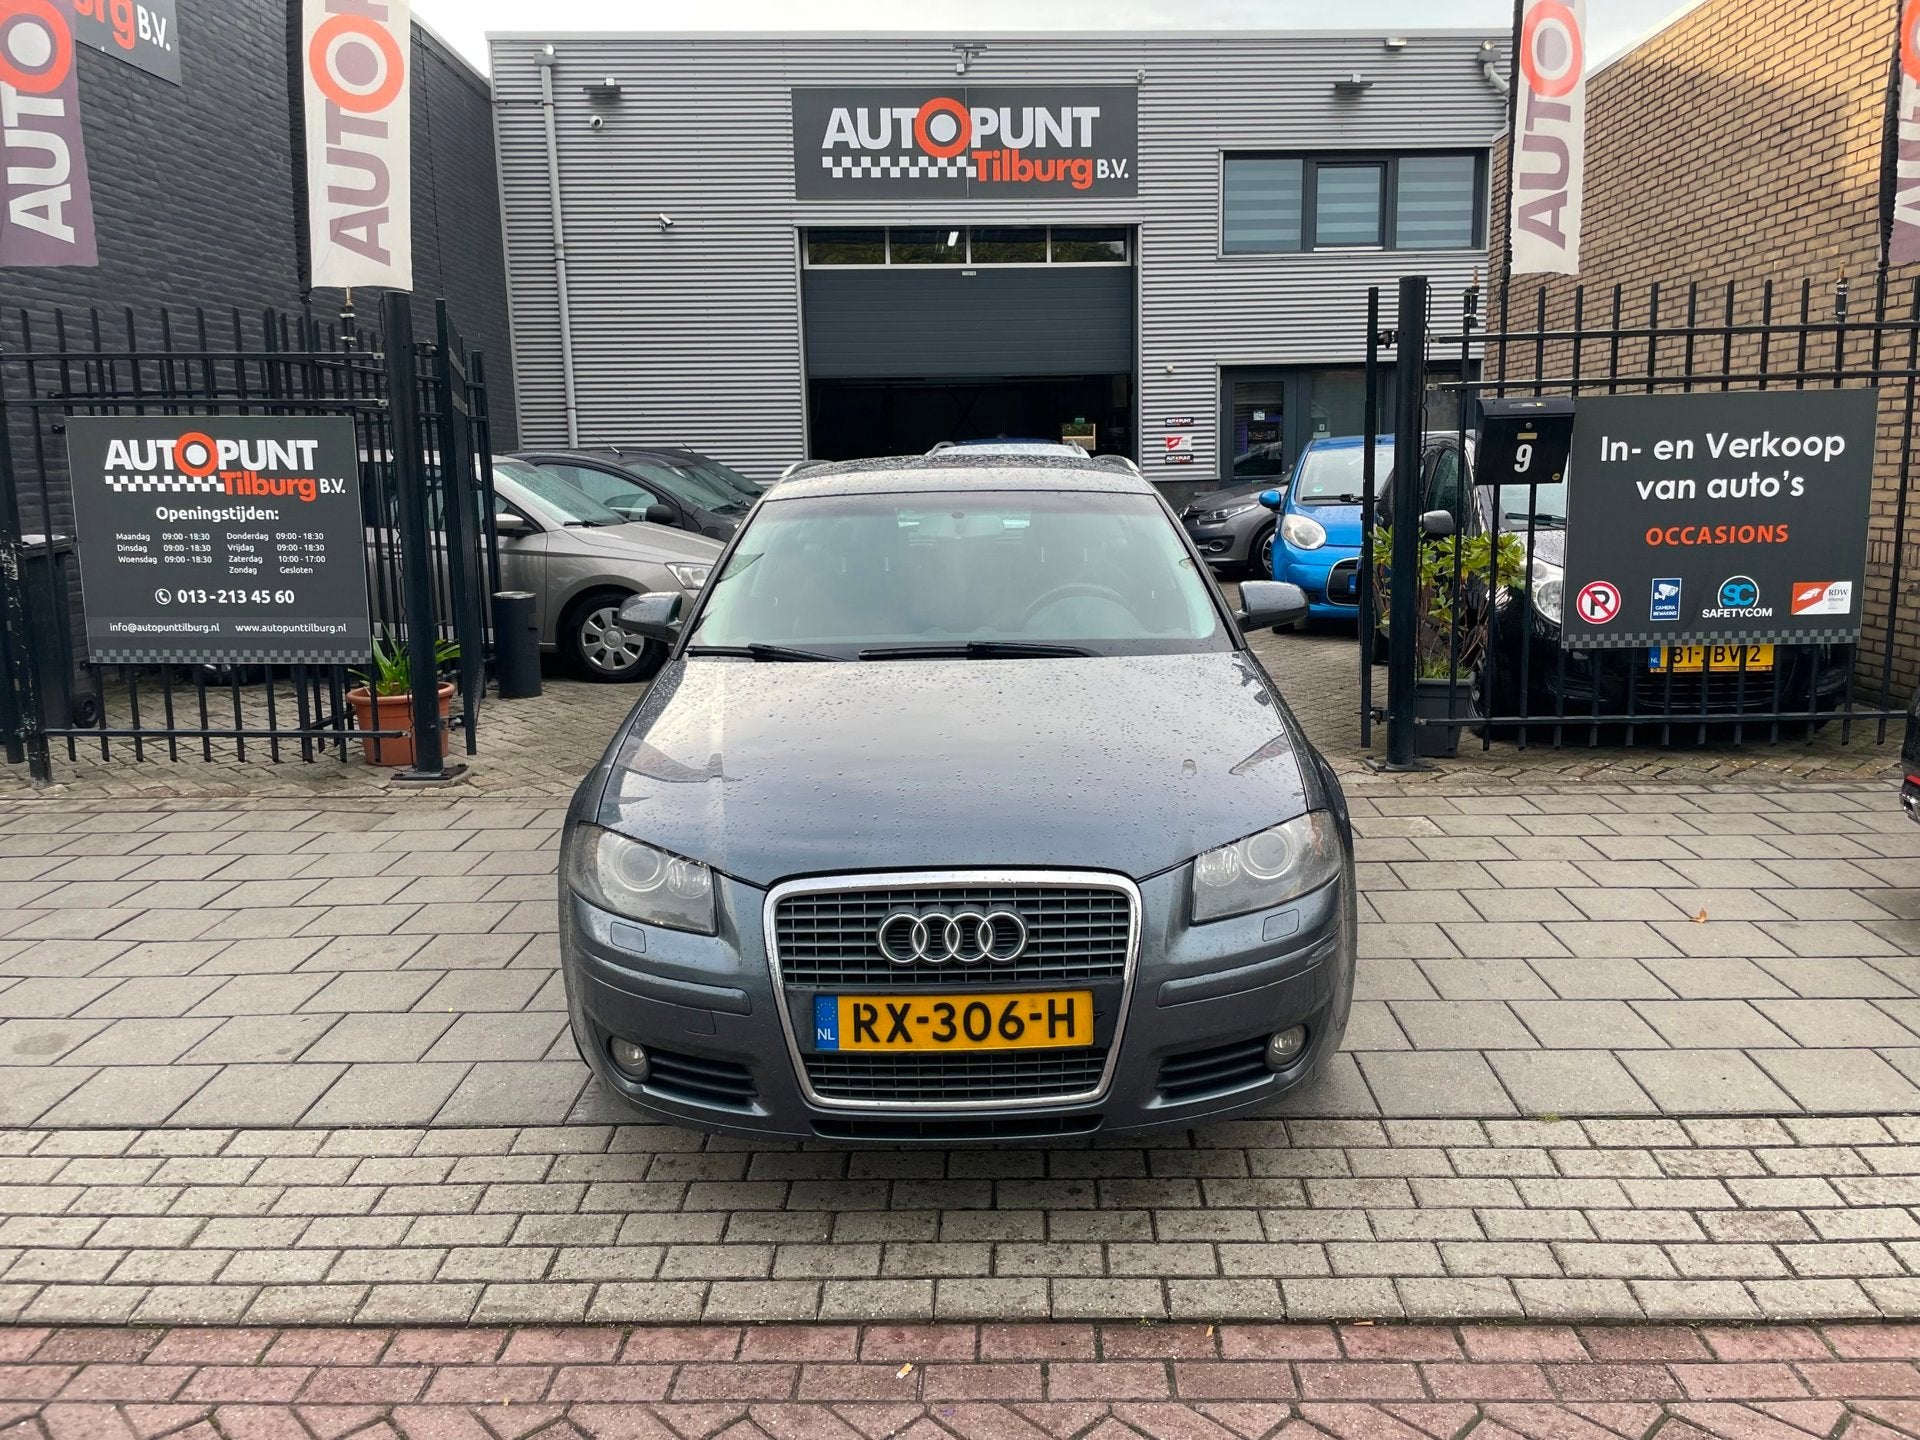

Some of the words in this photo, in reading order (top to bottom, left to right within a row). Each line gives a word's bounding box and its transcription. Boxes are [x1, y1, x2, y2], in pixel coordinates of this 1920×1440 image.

[137, 4, 171, 51] B.V.
[822, 97, 1100, 158] AUTOPUNT
[971, 149, 1093, 190] Tilburg
[1096, 158, 1129, 179] B.V.
[104, 431, 318, 477] AUTOPUNT
[1600, 436, 1641, 461] In-
[1653, 439, 1694, 460] en
[1706, 431, 1846, 462] Verkoop
[1514, 444, 1533, 473] 9
[219, 471, 317, 502] Tilburg
[319, 478, 346, 494] B.V.
[1636, 479, 1696, 500] van
[1707, 471, 1805, 499] auto's
[155, 506, 280, 522] Openingstijden:
[116, 533, 150, 541] Maandag
[226, 532, 268, 541] Donderdag
[1645, 524, 1789, 546] OCCASIONS
[117, 544, 147, 553] Dinsdag
[227, 543, 254, 552] Vrijdag
[118, 556, 157, 564] Woensdag
[228, 555, 263, 564] Zaterdag
[229, 566, 257, 575] Zondag
[280, 566, 313, 574] Gesloten
[250, 590, 270, 604] 45
[274, 590, 295, 604] 60
[1702, 608, 1773, 618] SAFETYCOM
[109, 623, 220, 634] info@autopunttilburg.nl
[235, 624, 347, 634] www.autopunttilburg.nl
[853, 998, 1075, 1044] RX-306-H
[817, 1028, 835, 1041] NL
